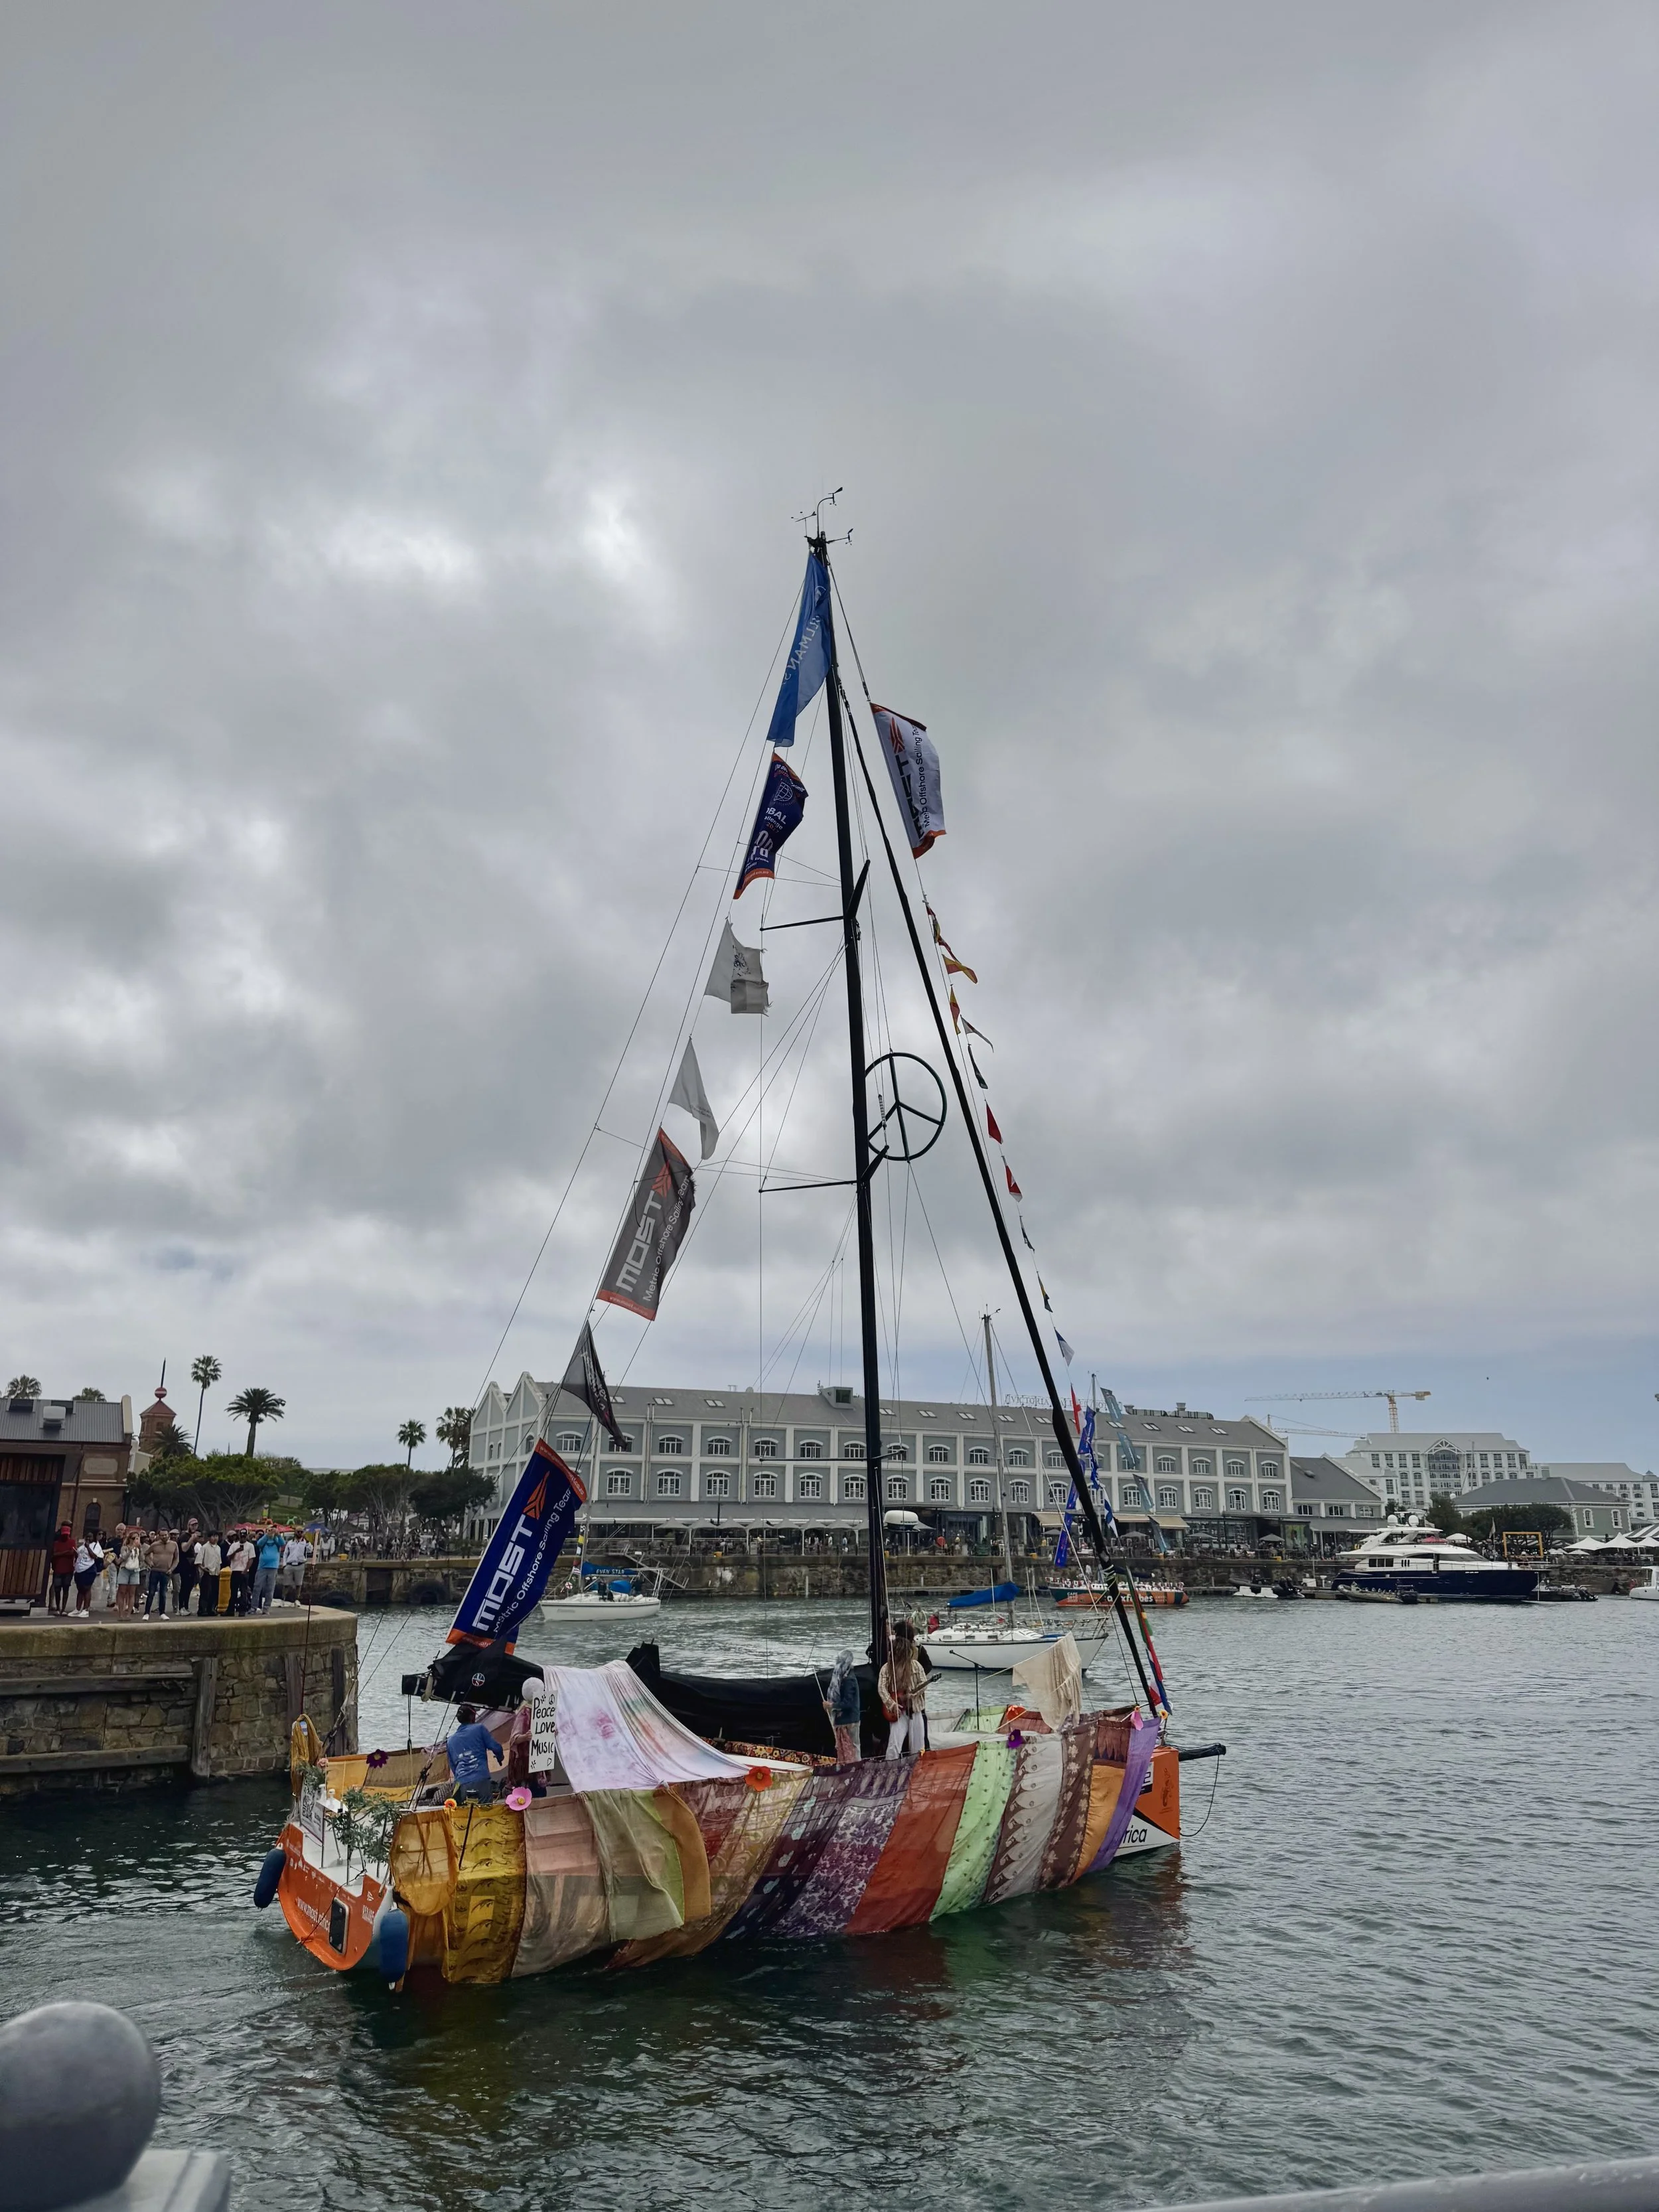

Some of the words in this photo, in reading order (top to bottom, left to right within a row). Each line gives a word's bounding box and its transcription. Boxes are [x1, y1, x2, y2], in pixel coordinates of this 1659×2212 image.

[914, 737, 923, 765] Sailing
[918, 767, 927, 805] Offshore
[616, 1190, 662, 1293] MOST
[643, 1266, 660, 1301] Metric
[656, 1224, 673, 1265] Offshore
[1011, 1396, 1049, 1405] VICTORIA
[472, 1514, 533, 1631] MOST
[516, 1552, 543, 1601] Offshore
[539, 1512, 560, 1551] Sailing
[533, 1697, 555, 1720] Peace
